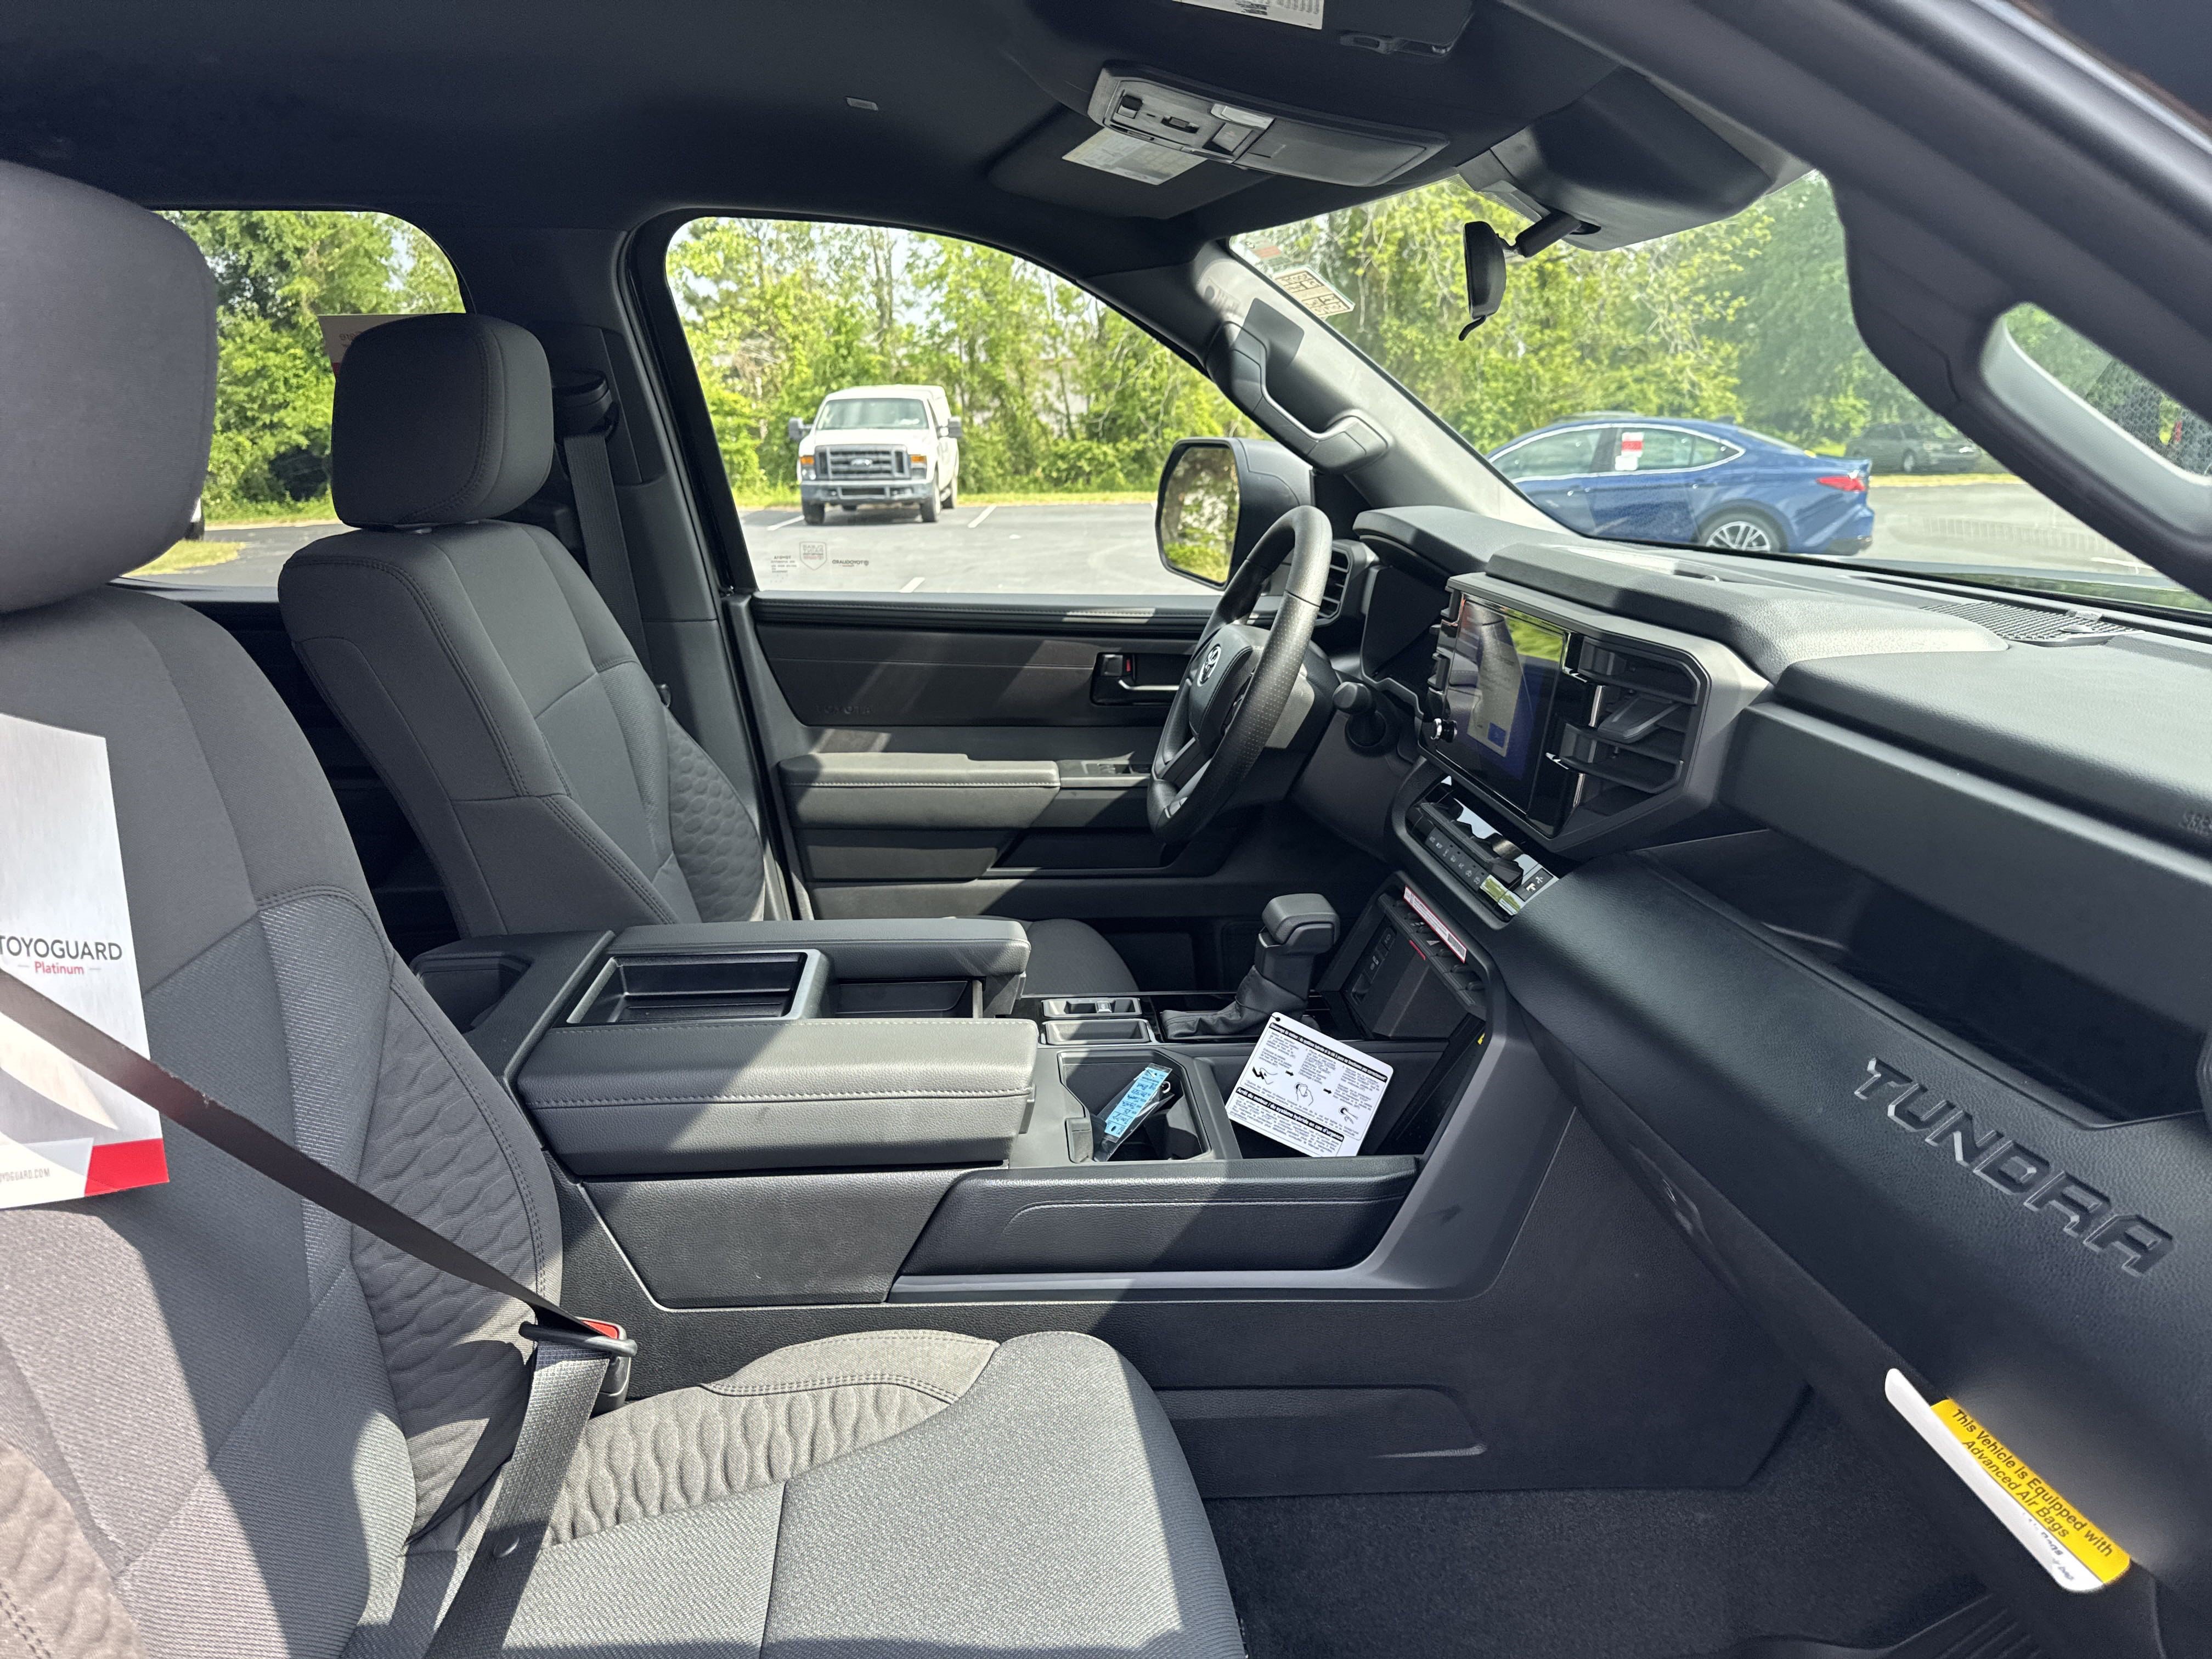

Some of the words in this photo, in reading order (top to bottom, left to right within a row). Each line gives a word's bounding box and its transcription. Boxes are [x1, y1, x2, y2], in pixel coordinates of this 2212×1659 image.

[0, 935, 122, 961] TOYOGUARD
[34, 961, 84, 975] Platinum
[0, 1167, 50, 1182] YOGUARD.COM
[1854, 1057, 2174, 1278] TUNDRA
[1952, 1409, 1977, 1432] This
[1976, 1430, 2016, 1468] Vehicle
[2014, 1466, 2028, 1480] is
[2027, 1477, 2087, 1531] Equipped
[2084, 1530, 2113, 1557] with
[1962, 1441, 2022, 1490] Advanced
[2016, 1491, 2039, 1506] Air
[2036, 1506, 2069, 1538] Bags
